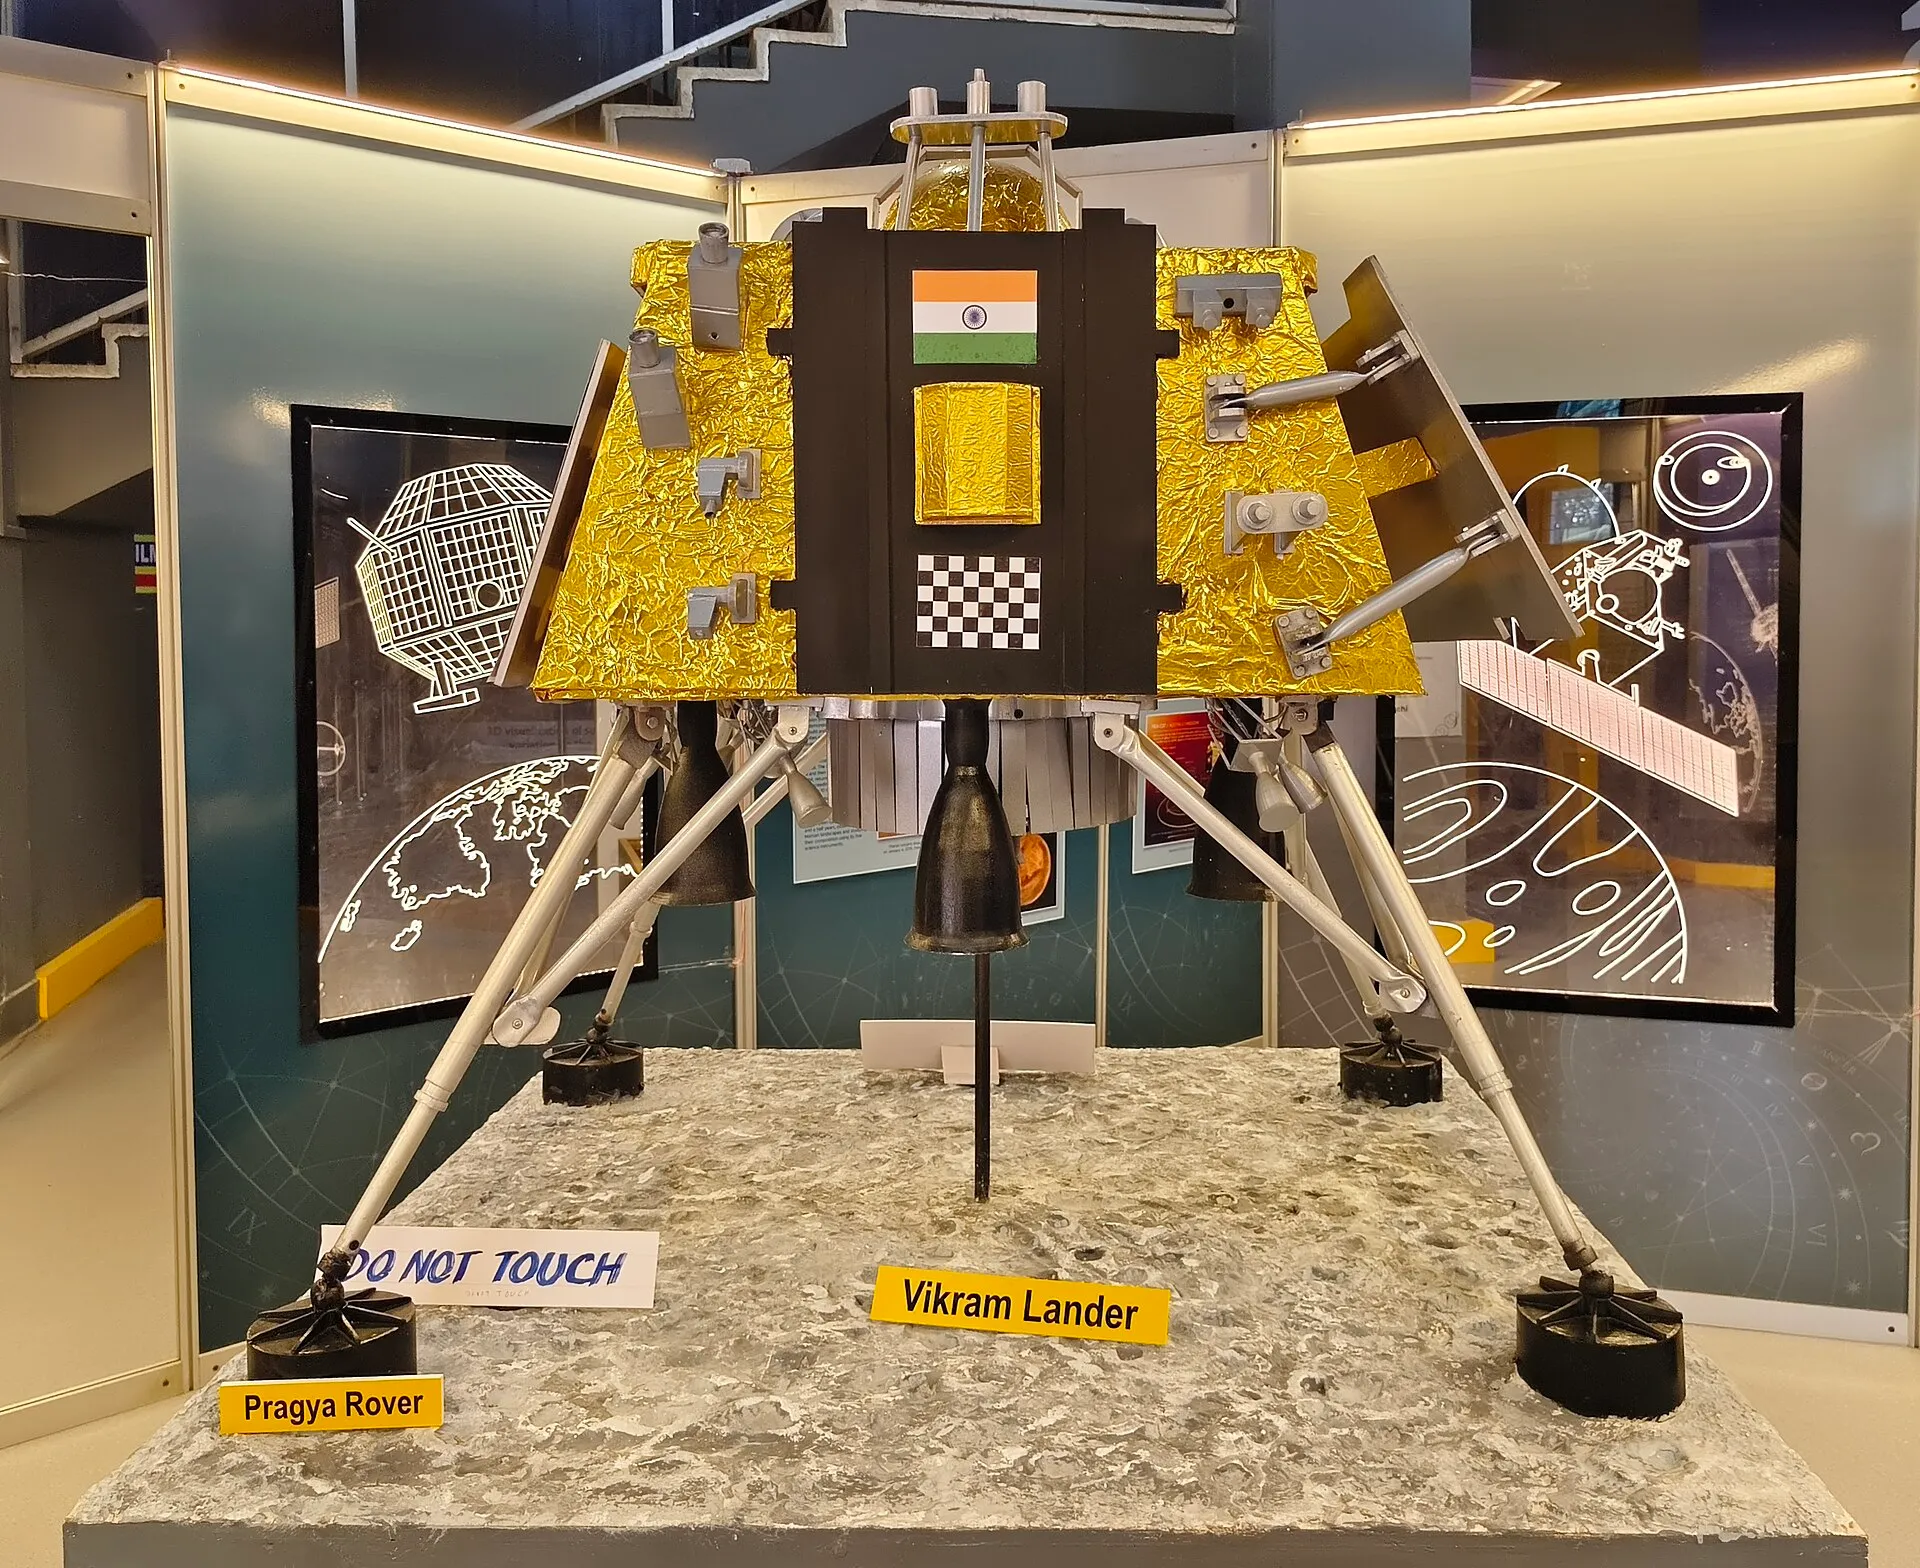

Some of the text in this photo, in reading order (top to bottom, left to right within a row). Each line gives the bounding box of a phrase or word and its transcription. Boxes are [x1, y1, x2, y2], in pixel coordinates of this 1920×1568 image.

[345, 1249, 628, 1286] DO NOT TOUCH
[904, 1279, 1139, 1330] Vikram Lander
[245, 1391, 424, 1426] Pragya Rover
